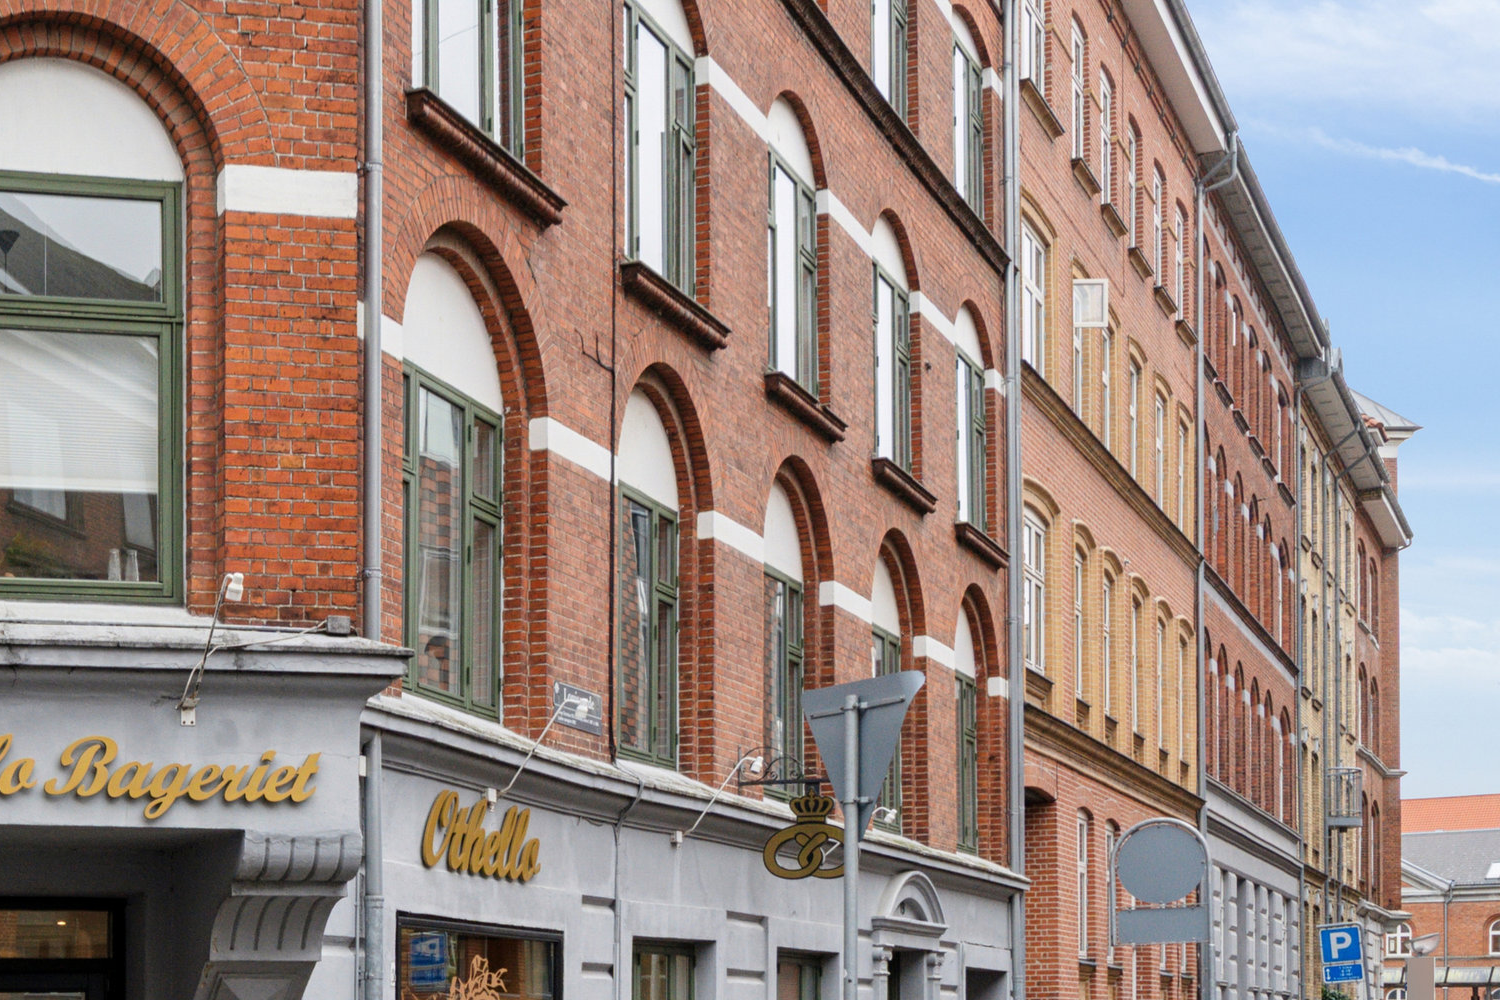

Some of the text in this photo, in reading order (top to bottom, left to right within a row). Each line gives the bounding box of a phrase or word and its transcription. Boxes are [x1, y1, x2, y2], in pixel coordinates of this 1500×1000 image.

[44, 735, 323, 820] Bageriet
[422, 789, 541, 882] Othello
[1330, 931, 1352, 960] P
